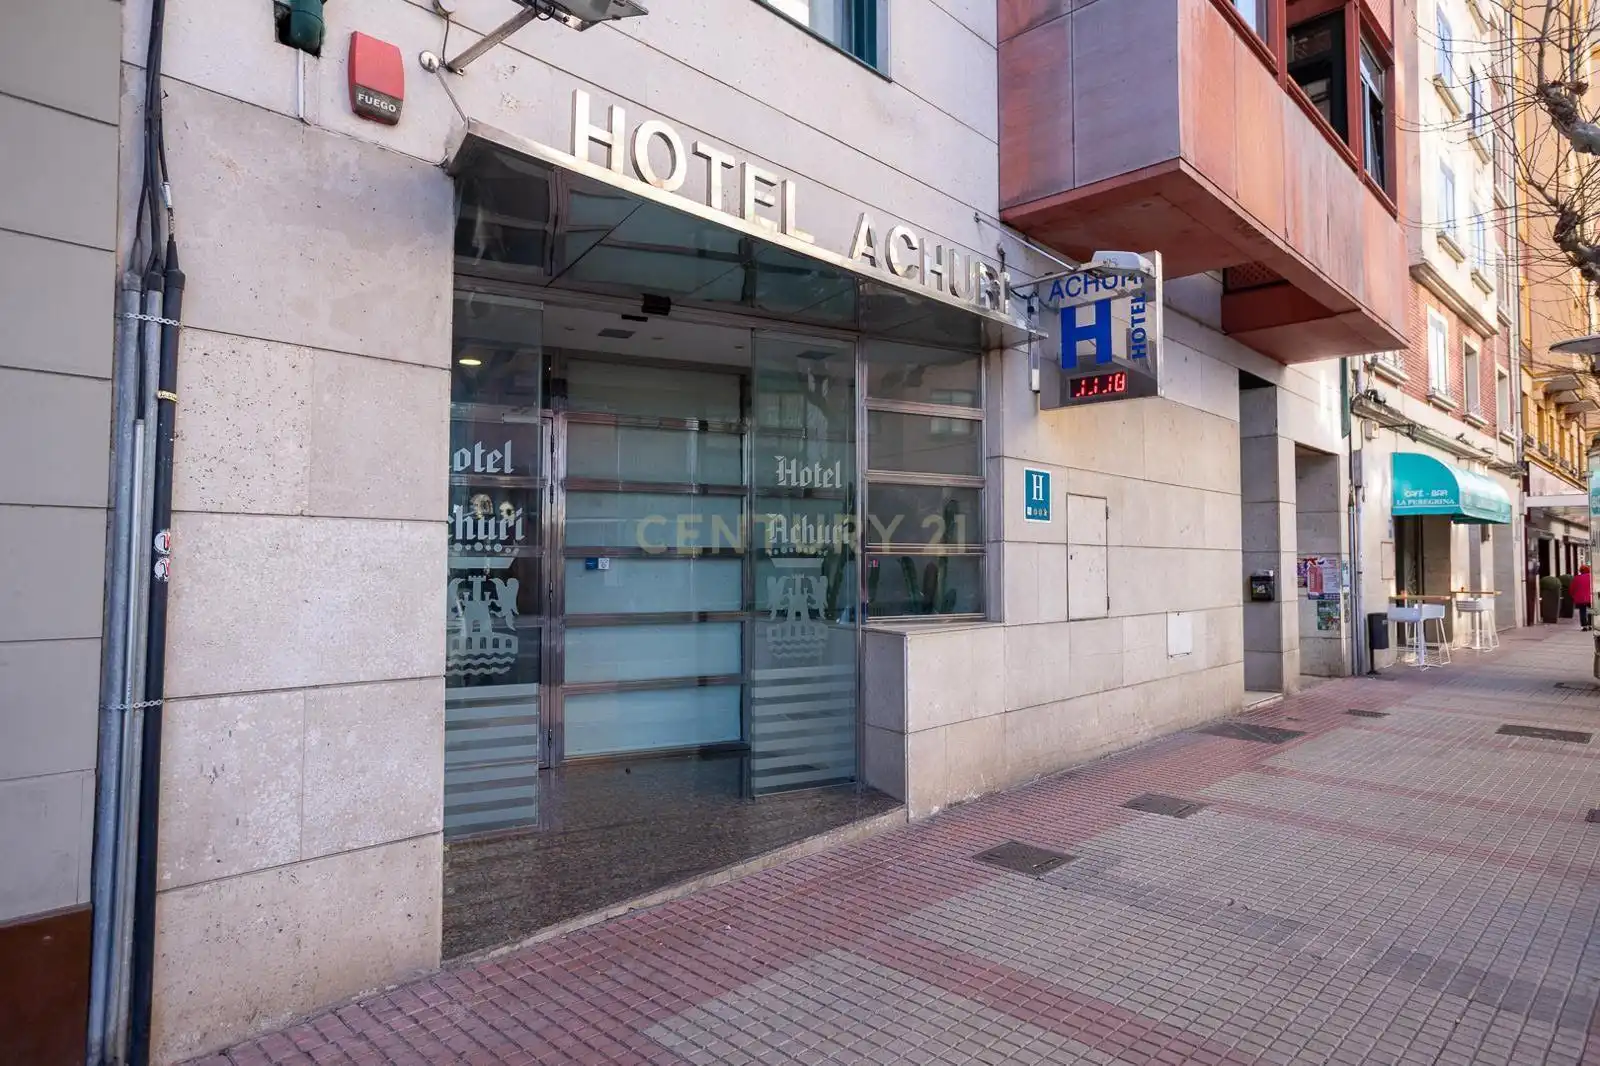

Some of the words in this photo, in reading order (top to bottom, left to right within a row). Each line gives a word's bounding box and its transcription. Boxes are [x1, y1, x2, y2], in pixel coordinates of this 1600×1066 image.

[357, 92, 397, 114] FUEGO
[570, 88, 815, 244] HOTEL
[848, 211, 1011, 315] ACHURI
[1061, 299, 1113, 369] H
[1131, 290, 1147, 360] HOTEL
[448, 439, 515, 474] otel
[773, 455, 843, 489] Hotel
